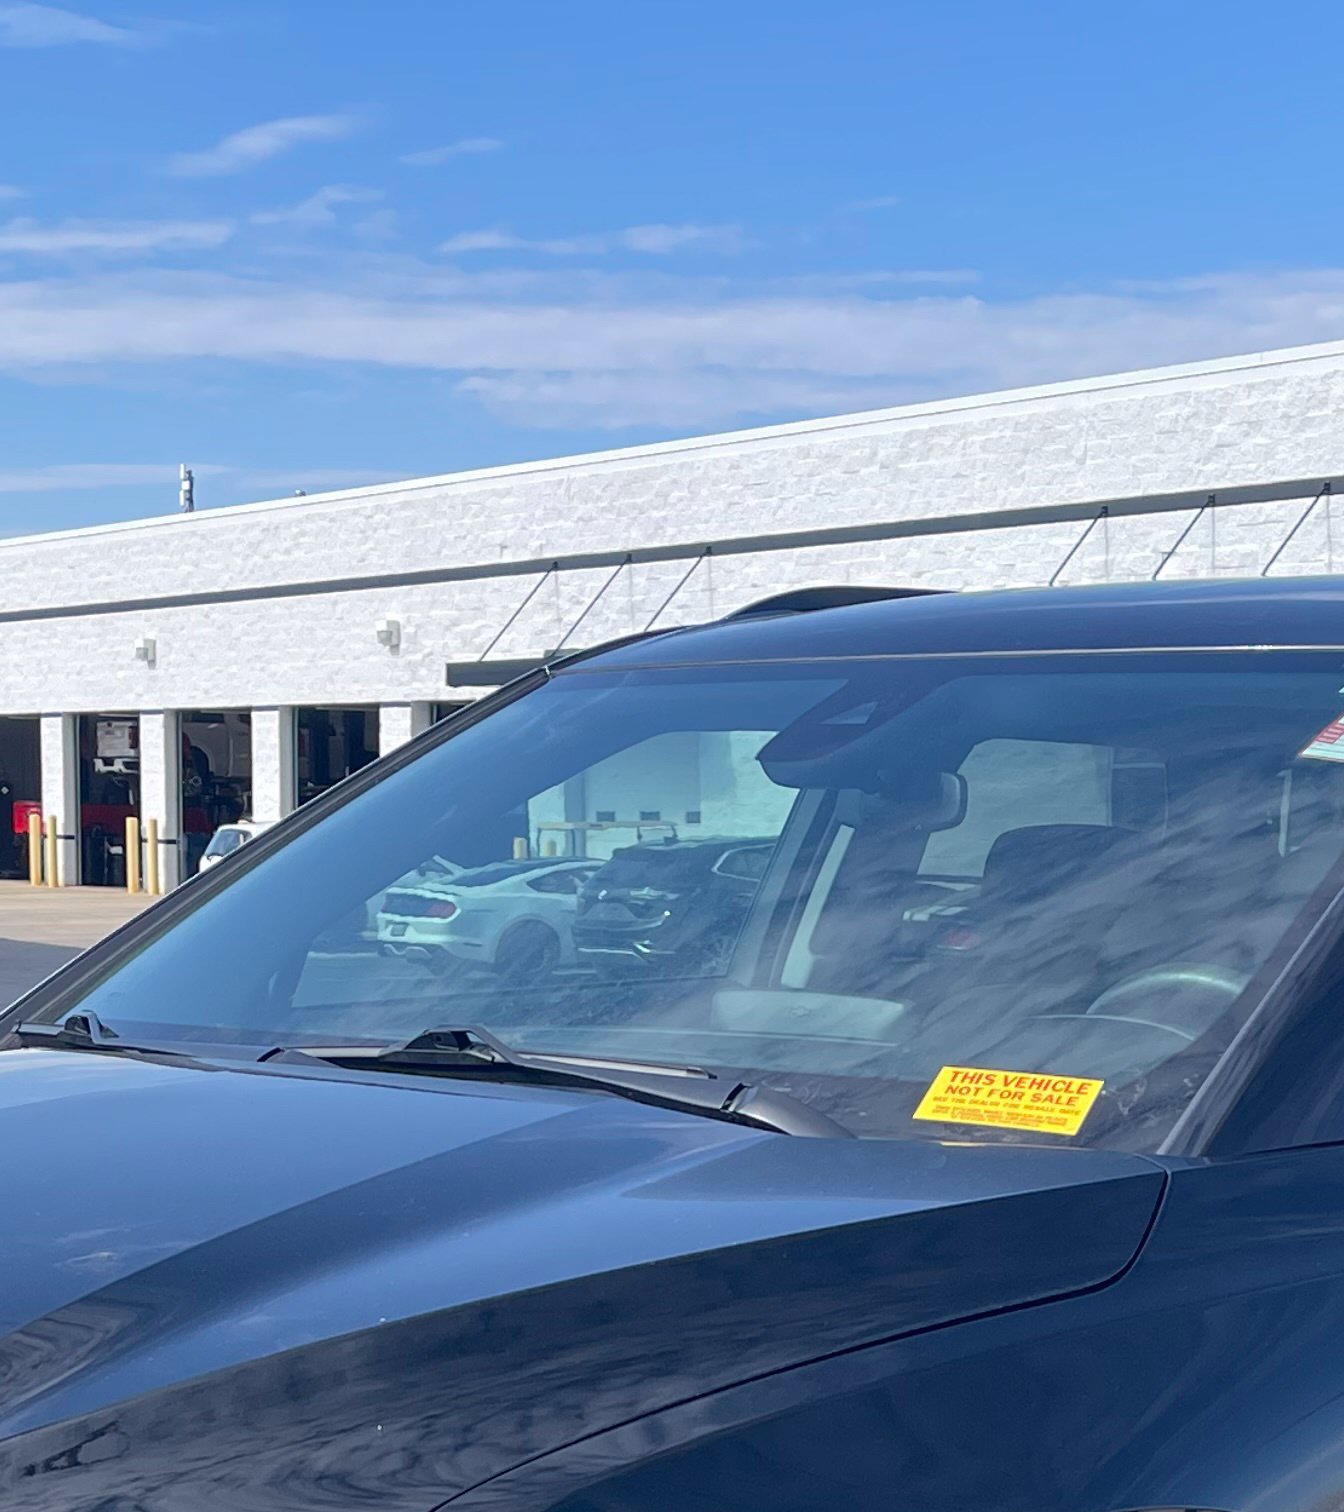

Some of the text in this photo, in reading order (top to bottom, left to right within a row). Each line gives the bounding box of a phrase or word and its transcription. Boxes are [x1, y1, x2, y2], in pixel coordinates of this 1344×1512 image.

[950, 1071, 1092, 1095] THIS VEHICLE
[944, 1085, 1080, 1107] NOT FOR SALE
